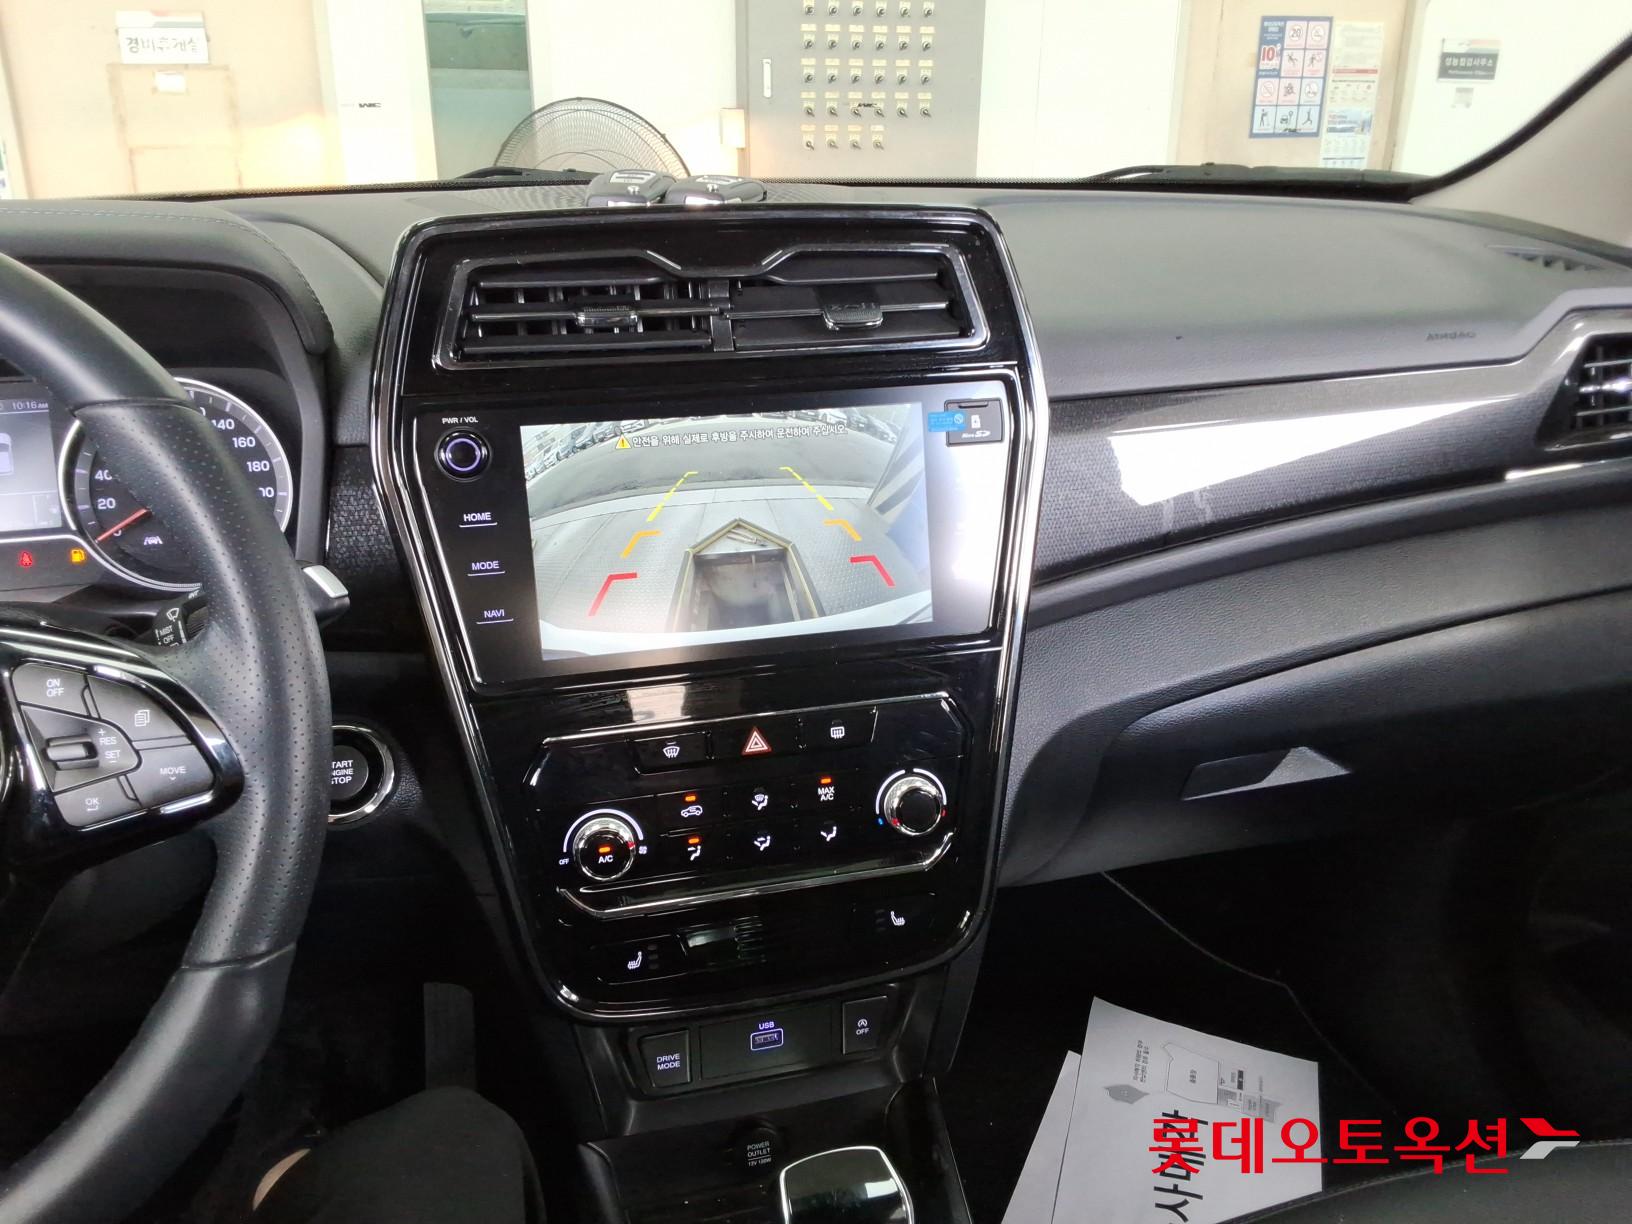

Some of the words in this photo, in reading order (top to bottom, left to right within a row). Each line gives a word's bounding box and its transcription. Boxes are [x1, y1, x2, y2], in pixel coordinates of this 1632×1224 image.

[632, 435, 660, 448] 안전을
[662, 433, 681, 446] 위해
[682, 431, 709, 445] 실제로
[711, 430, 738, 443] 후방을
[740, 428, 774, 440] 주시하여
[777, 426, 810, 439] 운전하여
[232, 437, 256, 448] 160
[246, 461, 270, 472] 180
[259, 487, 275, 498] 10
[97, 498, 116, 510] 20
[463, 511, 492, 522] HOME
[471, 561, 500, 571] MODE
[483, 609, 505, 618] NAVI
[160, 625, 172, 636] MIST
[163, 634, 175, 644] OFF
[46, 679, 60, 687] ON
[46, 687, 65, 697] OFF
[99, 737, 117, 745] RES
[105, 750, 121, 759] SET
[332, 760, 354, 769] TART
[160, 766, 187, 775] MOVE
[332, 768, 354, 776] NGINE
[817, 786, 835, 795] MAX
[85, 797, 100, 806] OK
[820, 793, 834, 801] A/C
[598, 855, 613, 864] A/C
[758, 1021, 775, 1030] USB
[856, 1027, 870, 1036] OFF
[656, 1053, 681, 1063] DRIVE
[657, 1061, 681, 1071] MODE
[747, 1141, 770, 1151] POWER
[747, 1147, 771, 1158] OUTLET
